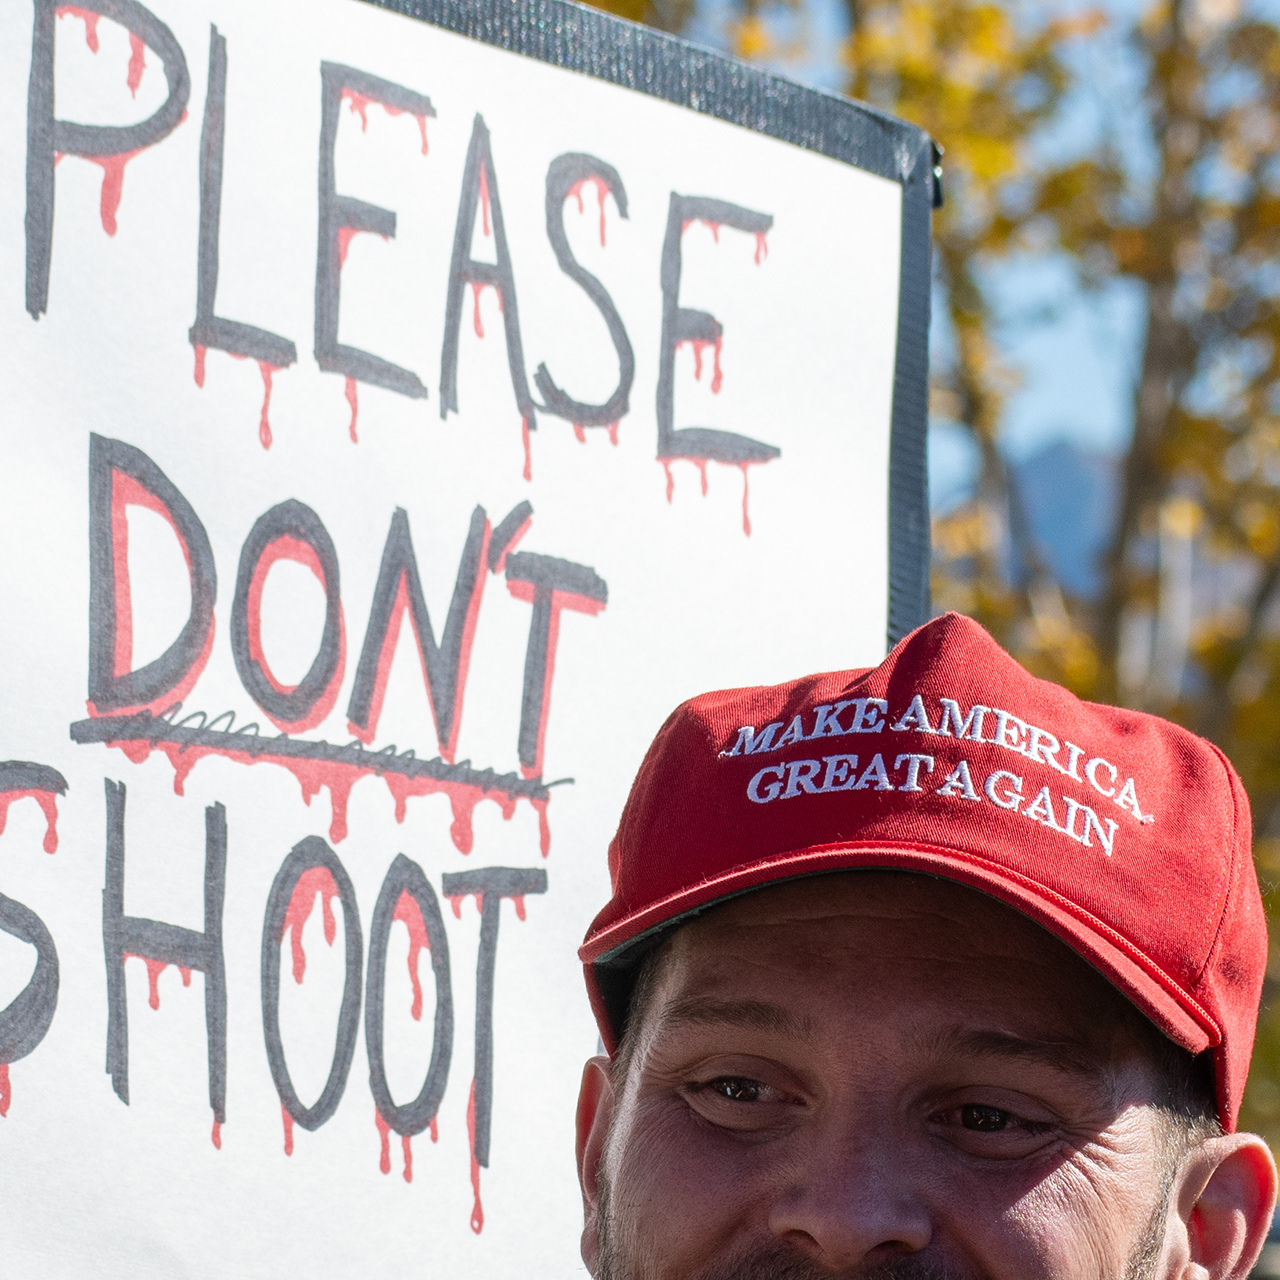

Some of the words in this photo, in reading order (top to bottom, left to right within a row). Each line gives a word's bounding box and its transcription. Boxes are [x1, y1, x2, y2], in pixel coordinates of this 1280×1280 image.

[24, 0, 782, 480] PLEASE
[86, 432, 609, 780] DON'T
[718, 696, 889, 760] MAKE
[889, 693, 1156, 825] AMERICA
[746, 751, 934, 805] GREAT
[936, 759, 1120, 857] AGAIN
